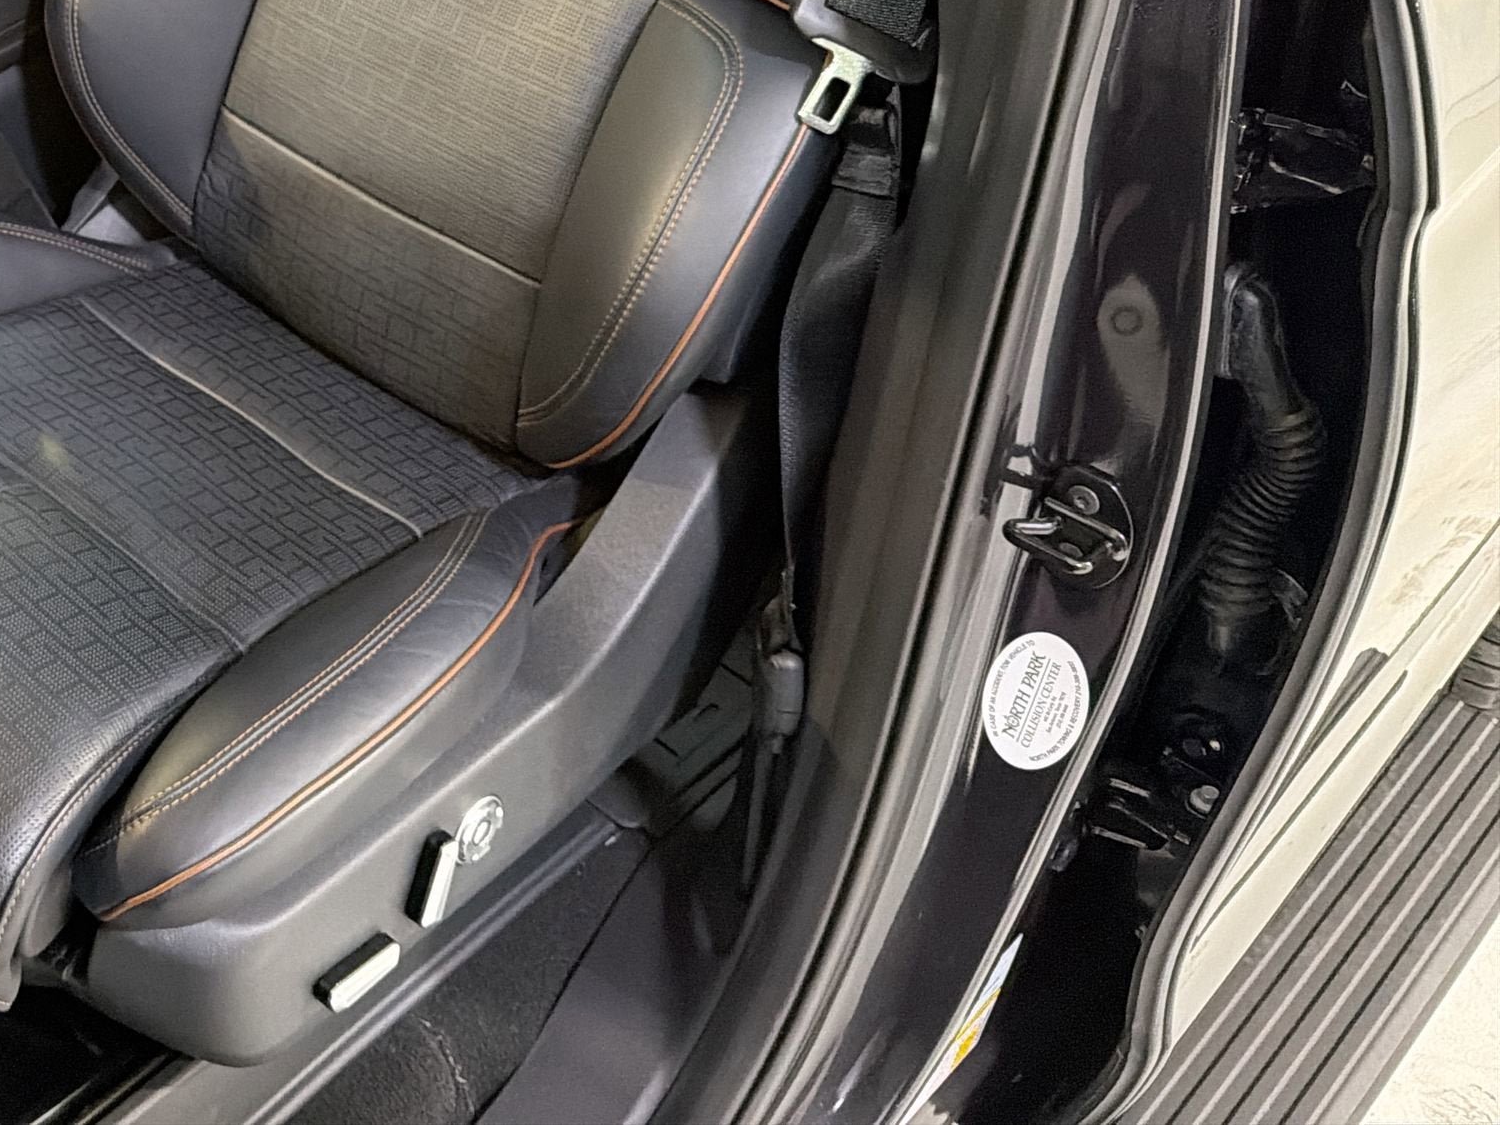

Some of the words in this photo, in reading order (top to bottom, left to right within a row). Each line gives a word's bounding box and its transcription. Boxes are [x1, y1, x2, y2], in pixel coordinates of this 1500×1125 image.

[989, 714, 997, 730] CASE
[1001, 687, 1031, 739] NORTH
[1020, 650, 1047, 690] PARK
[1020, 698, 1048, 748] COLLISION
[1040, 661, 1062, 699] CENTER
